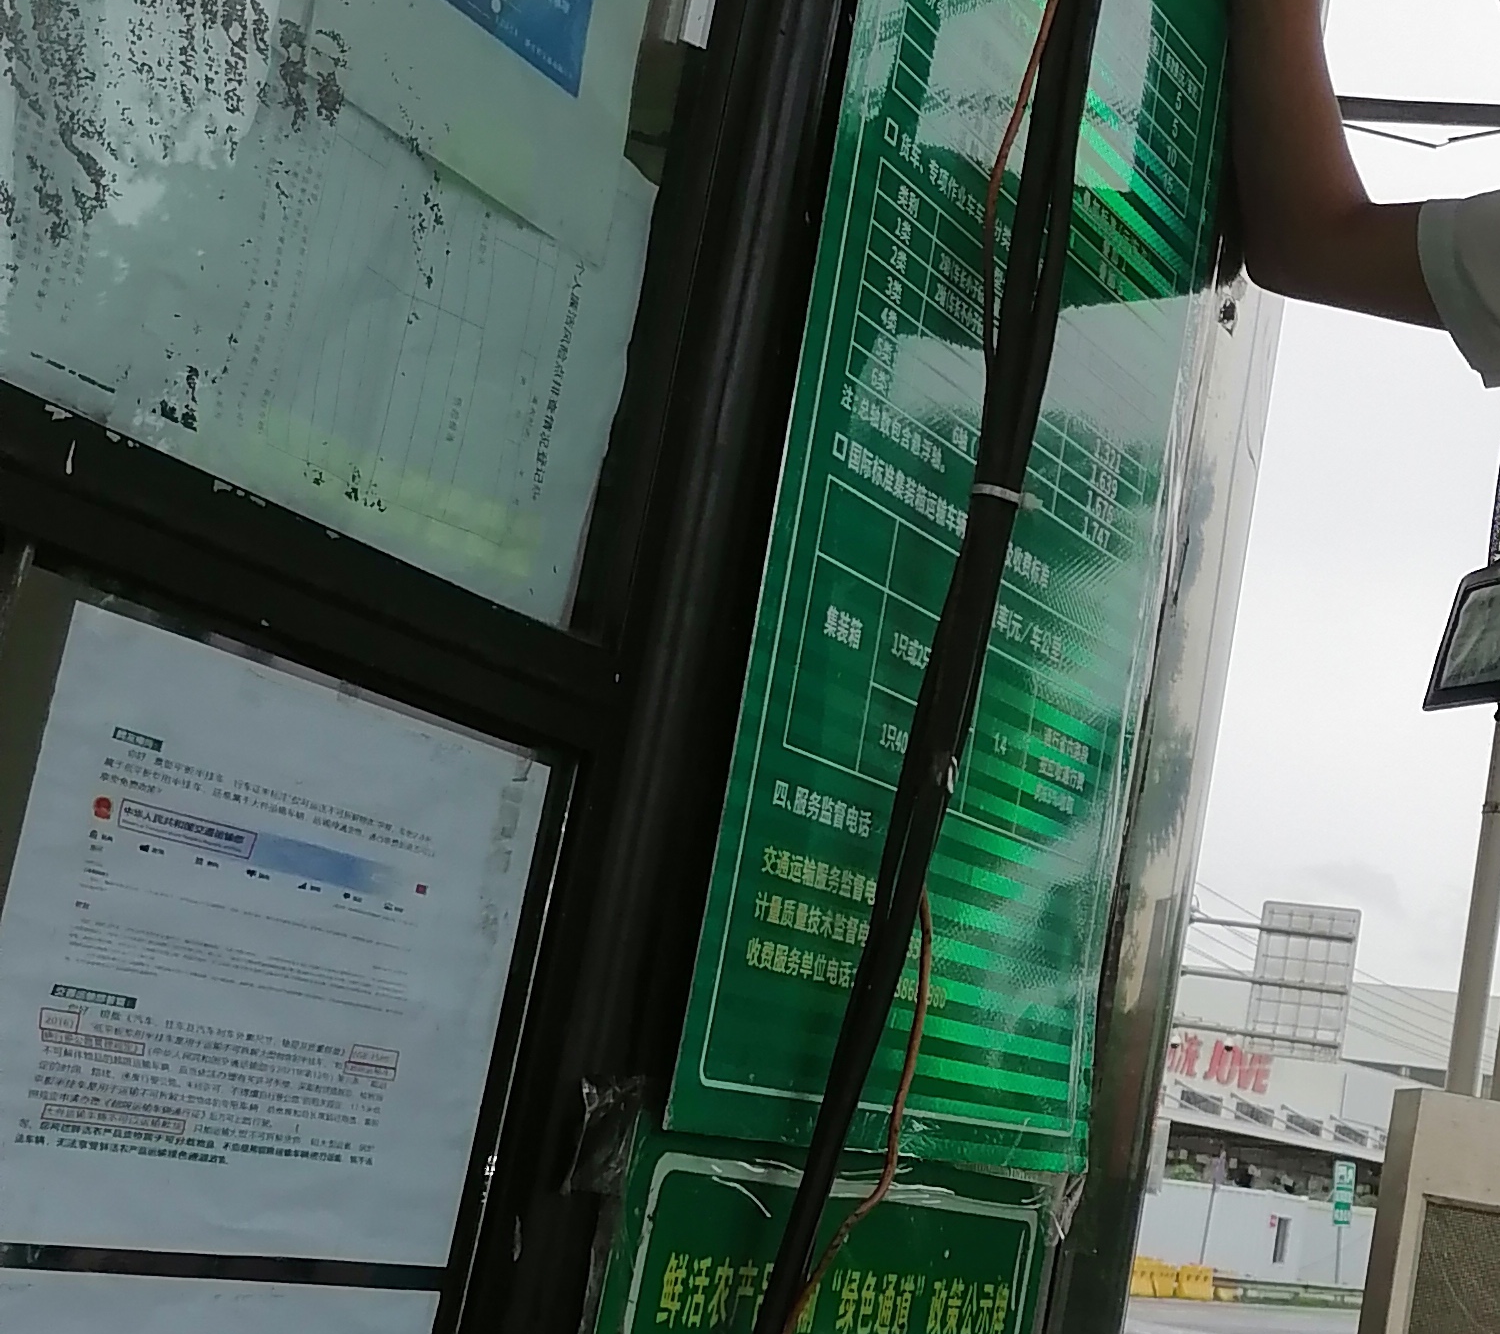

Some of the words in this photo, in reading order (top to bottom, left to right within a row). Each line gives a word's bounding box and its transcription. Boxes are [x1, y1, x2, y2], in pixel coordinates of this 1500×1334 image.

[895, 217, 911, 245] 1类
[891, 246, 907, 275] 2类
[886, 276, 902, 304] 3类
[881, 307, 897, 334] 4类
[824, 605, 863, 650] 集装箱
[772, 779, 872, 838] 四、服务监督电话
